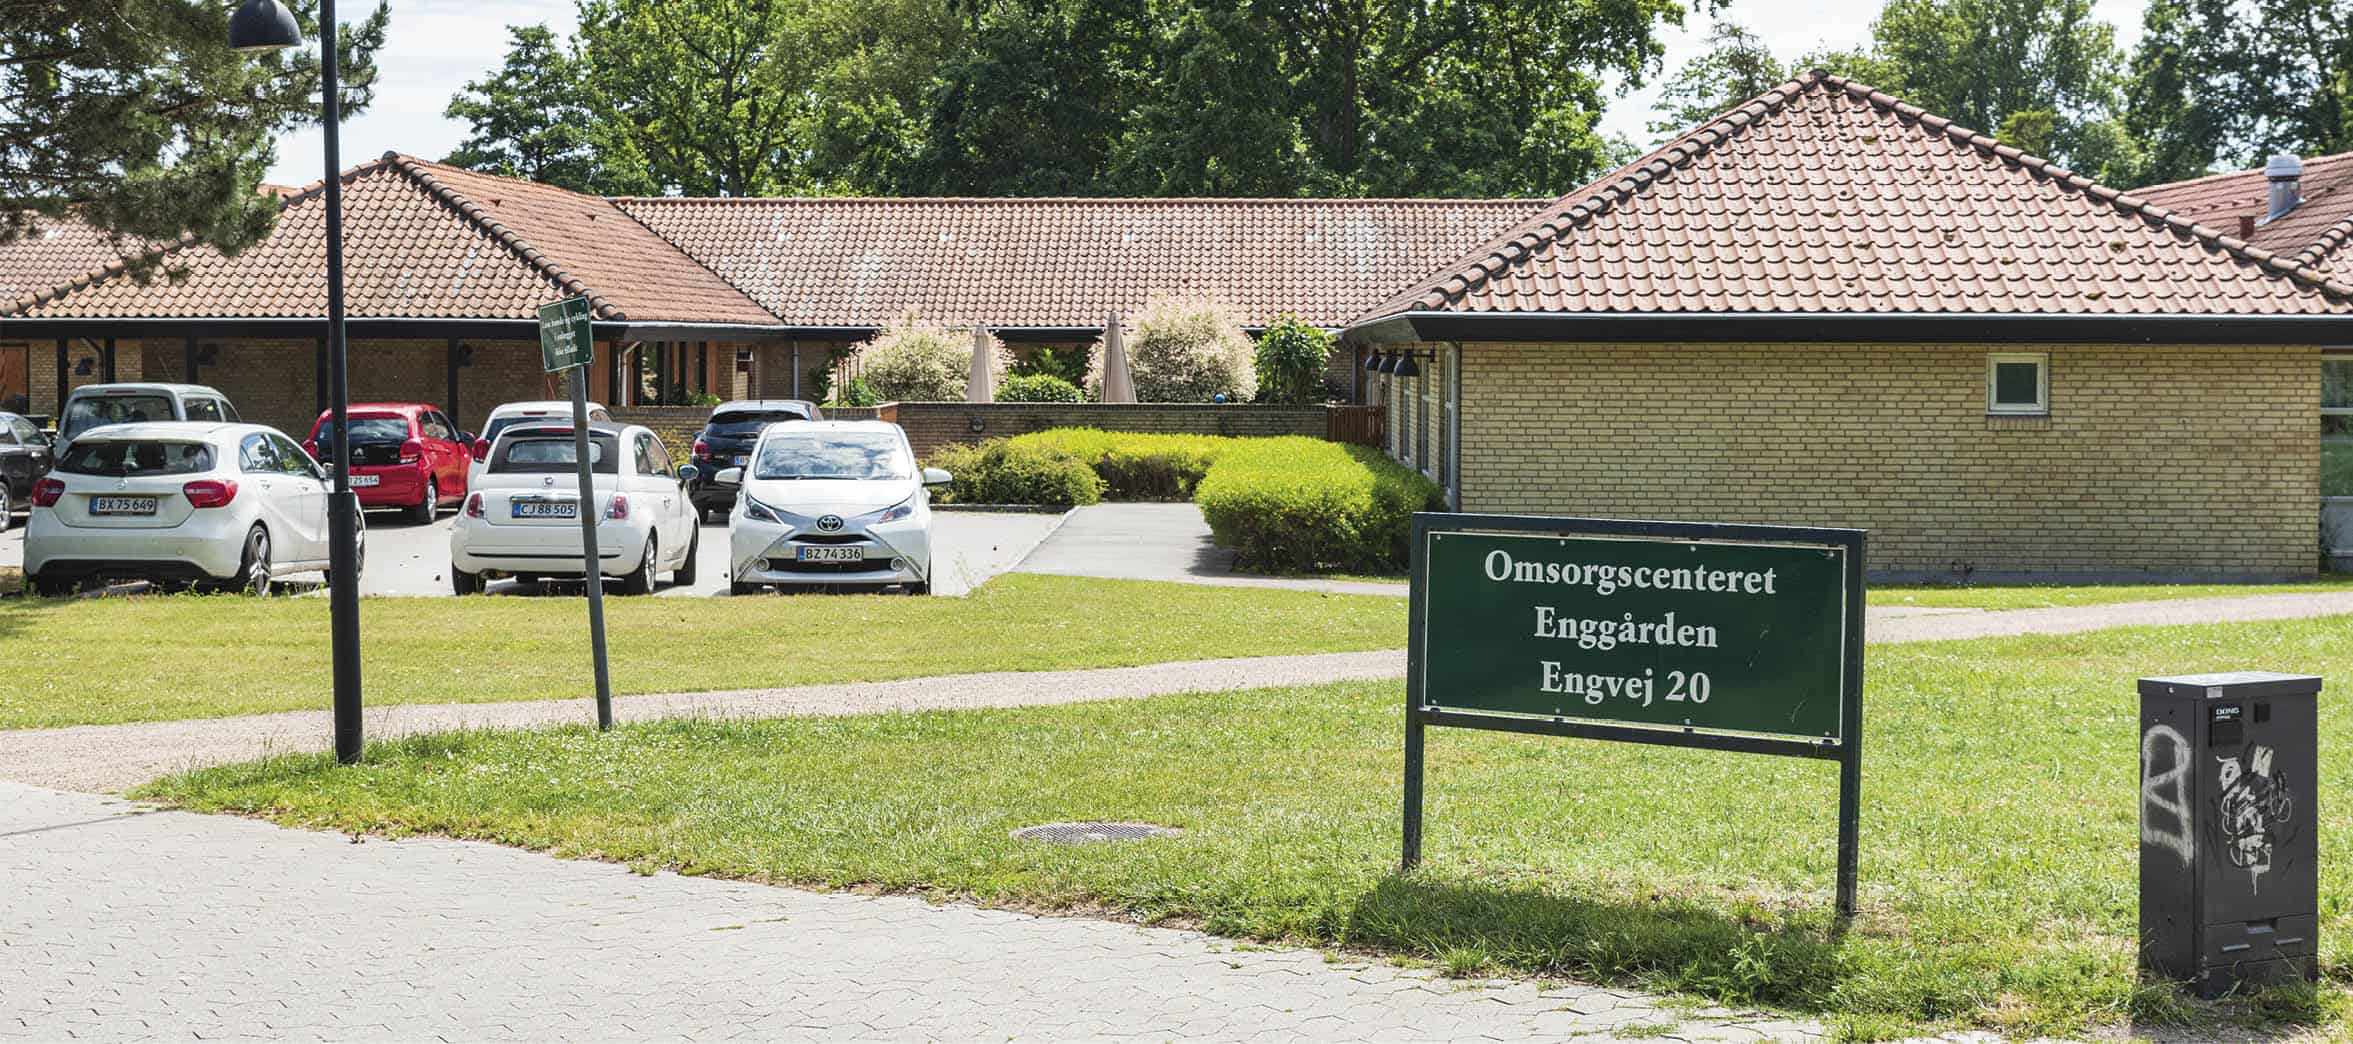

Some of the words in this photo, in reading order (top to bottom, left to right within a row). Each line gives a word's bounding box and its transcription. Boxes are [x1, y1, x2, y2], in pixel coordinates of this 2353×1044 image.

[99, 496, 114, 510] BX
[117, 497, 130, 510] 75
[133, 497, 154, 510] 649
[521, 503, 534, 514] CJ
[538, 503, 551, 514] 88
[554, 503, 574, 514] 505
[805, 548, 822, 560] BZ
[824, 548, 838, 560] 74
[840, 548, 861, 560] 336
[1484, 550, 1777, 596] Omsorgscenteret
[1533, 606, 1719, 650] Enggården
[1540, 660, 1654, 707] Engvej
[1665, 670, 1711, 703] 20
